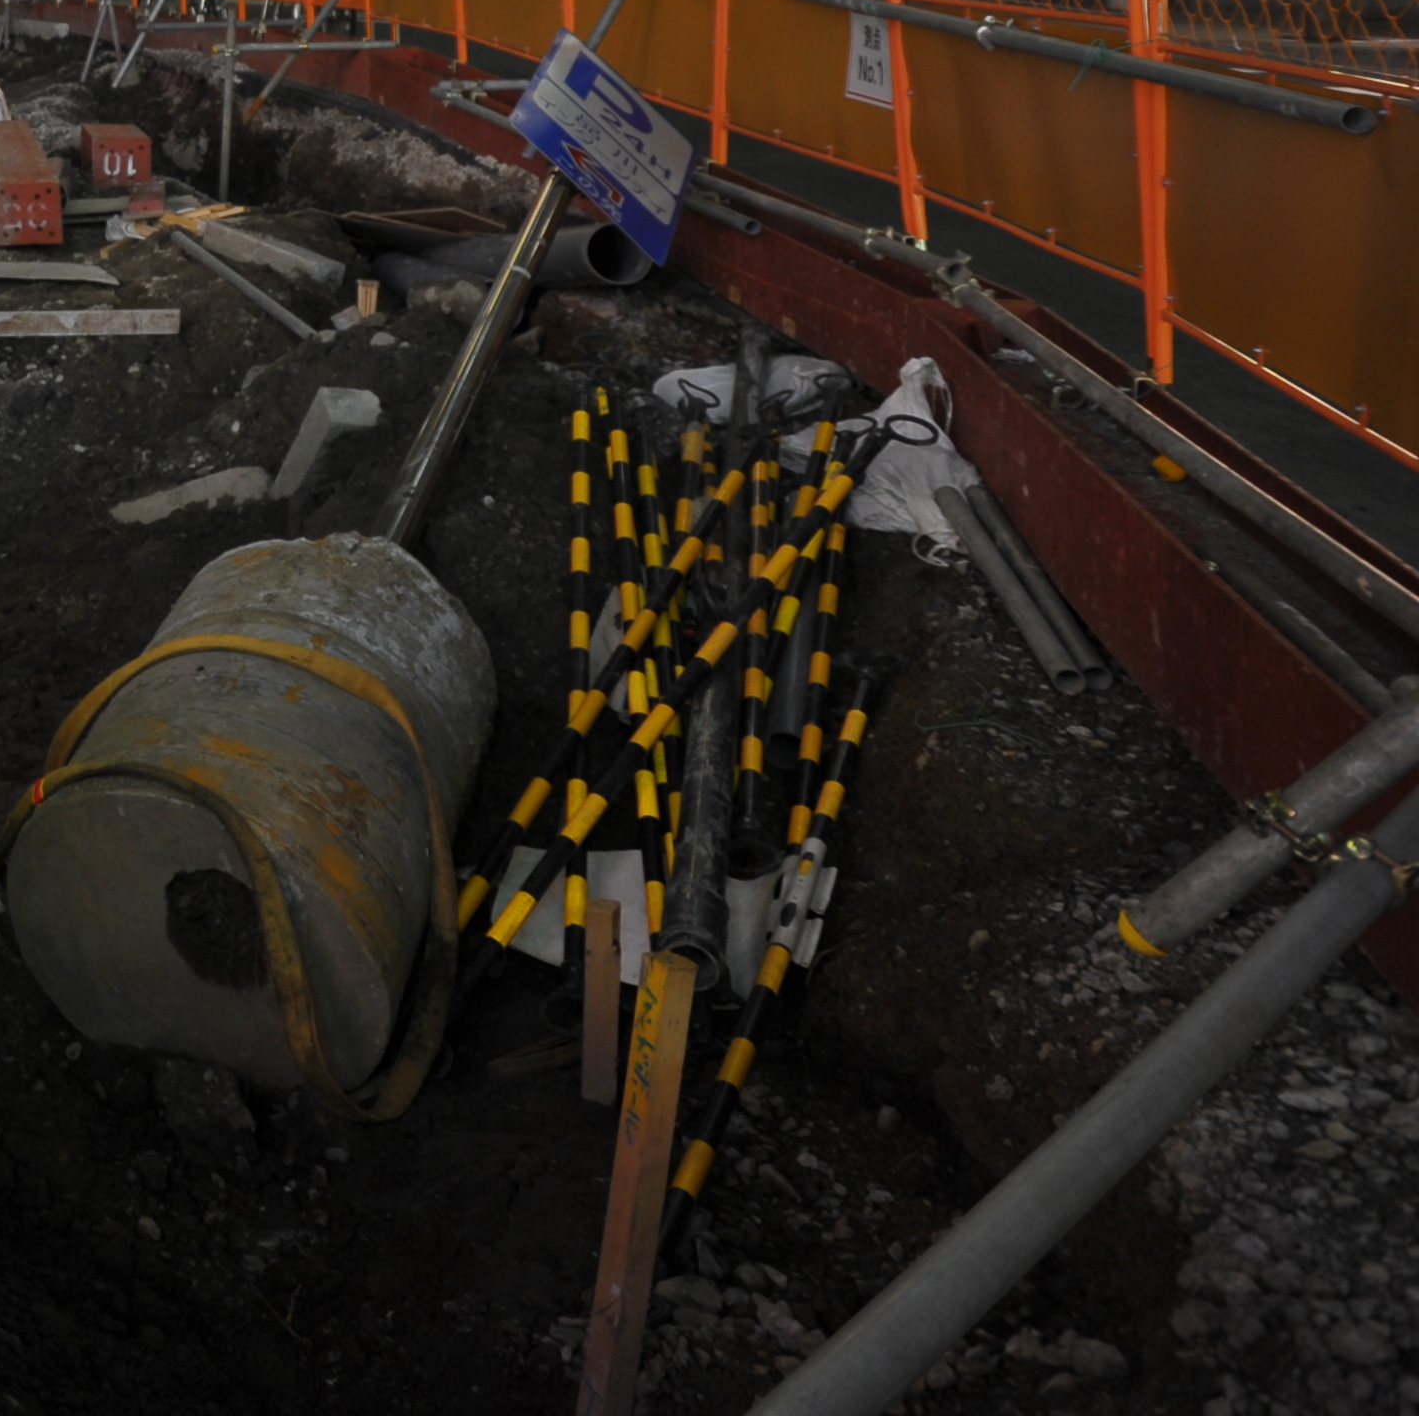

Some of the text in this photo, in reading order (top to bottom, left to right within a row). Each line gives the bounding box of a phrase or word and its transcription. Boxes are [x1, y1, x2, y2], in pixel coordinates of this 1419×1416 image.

[565, 51, 653, 134] P
[858, 55, 884, 86] No.1
[540, 95, 668, 216] インターシティ
[575, 114, 639, 176] 品川
[600, 107, 672, 181] 24H
[556, 156, 623, 223] この先
